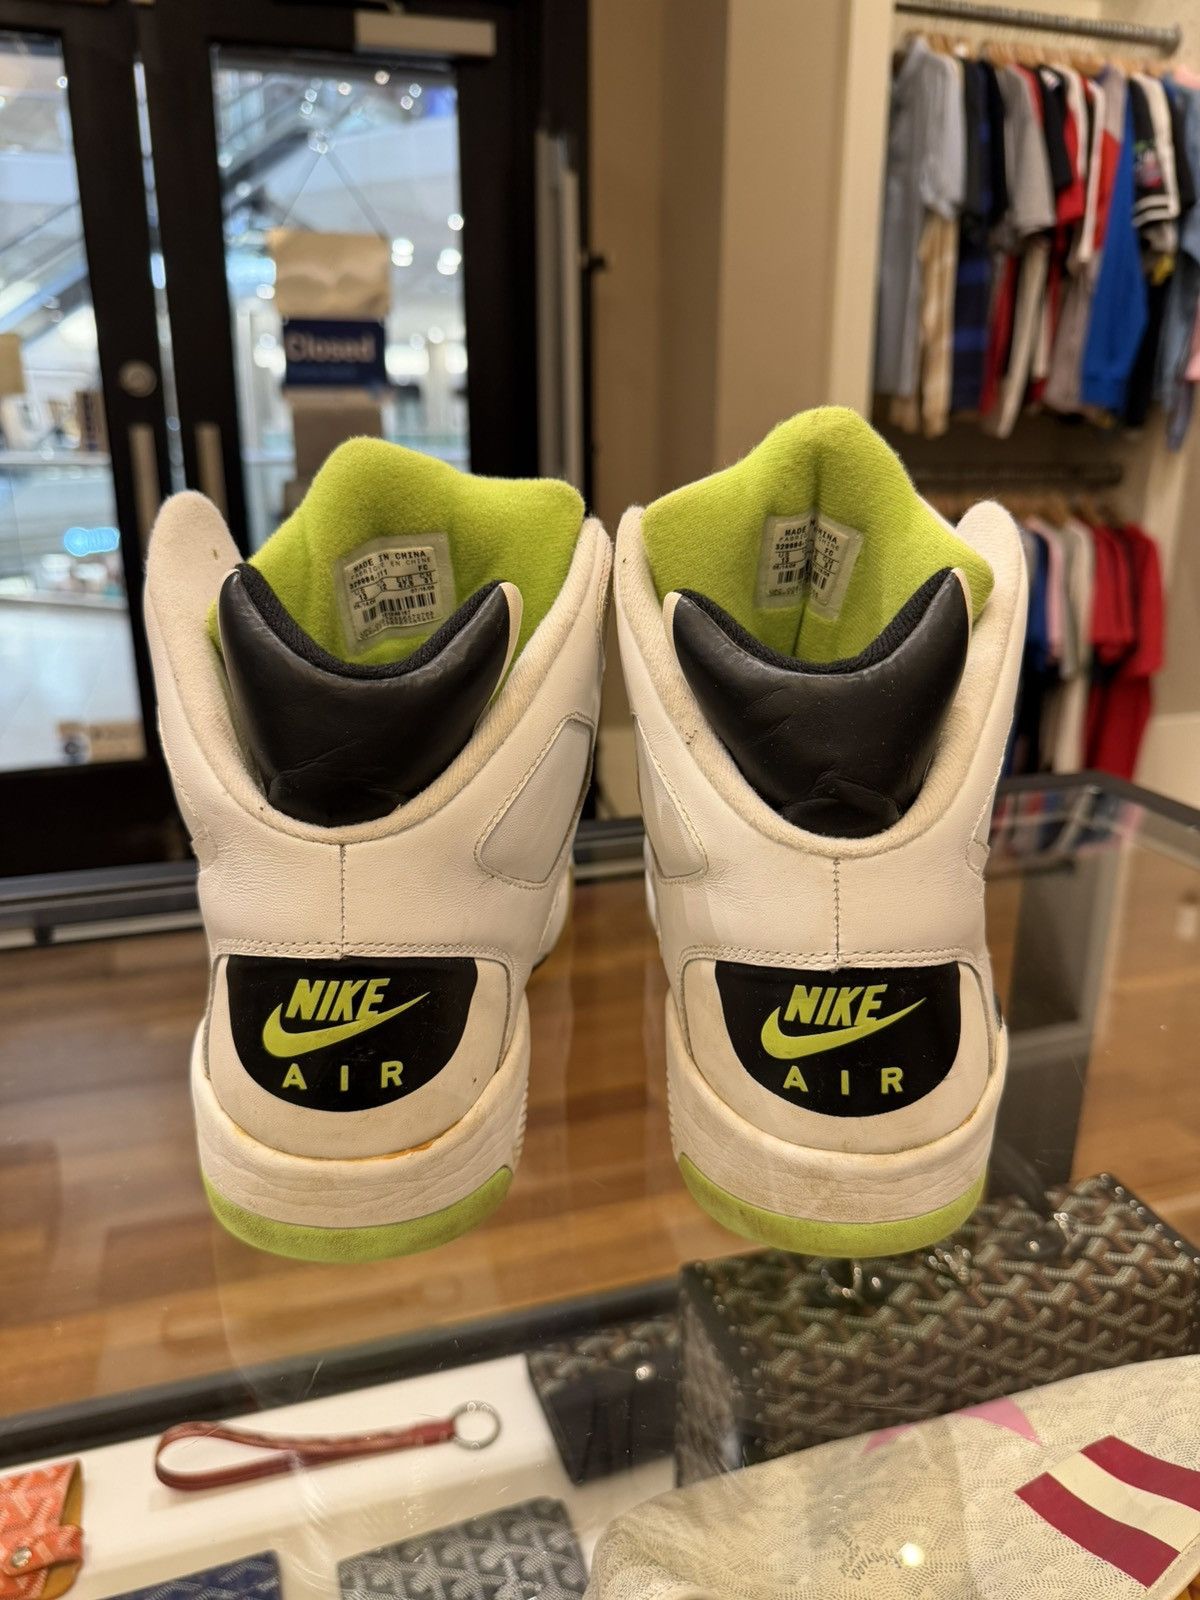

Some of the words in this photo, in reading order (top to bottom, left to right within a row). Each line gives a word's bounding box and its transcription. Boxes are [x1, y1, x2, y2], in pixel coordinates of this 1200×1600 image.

[284, 332, 376, 362] Closed
[785, 526, 806, 536] MADE
[354, 558, 374, 571] MADE
[378, 553, 389, 562] IN
[395, 551, 426, 560] CHINA
[285, 978, 390, 1020] NIKE
[784, 984, 888, 1026] NIKE
[282, 1061, 403, 1091] AIR
[783, 1066, 904, 1095] AIR
